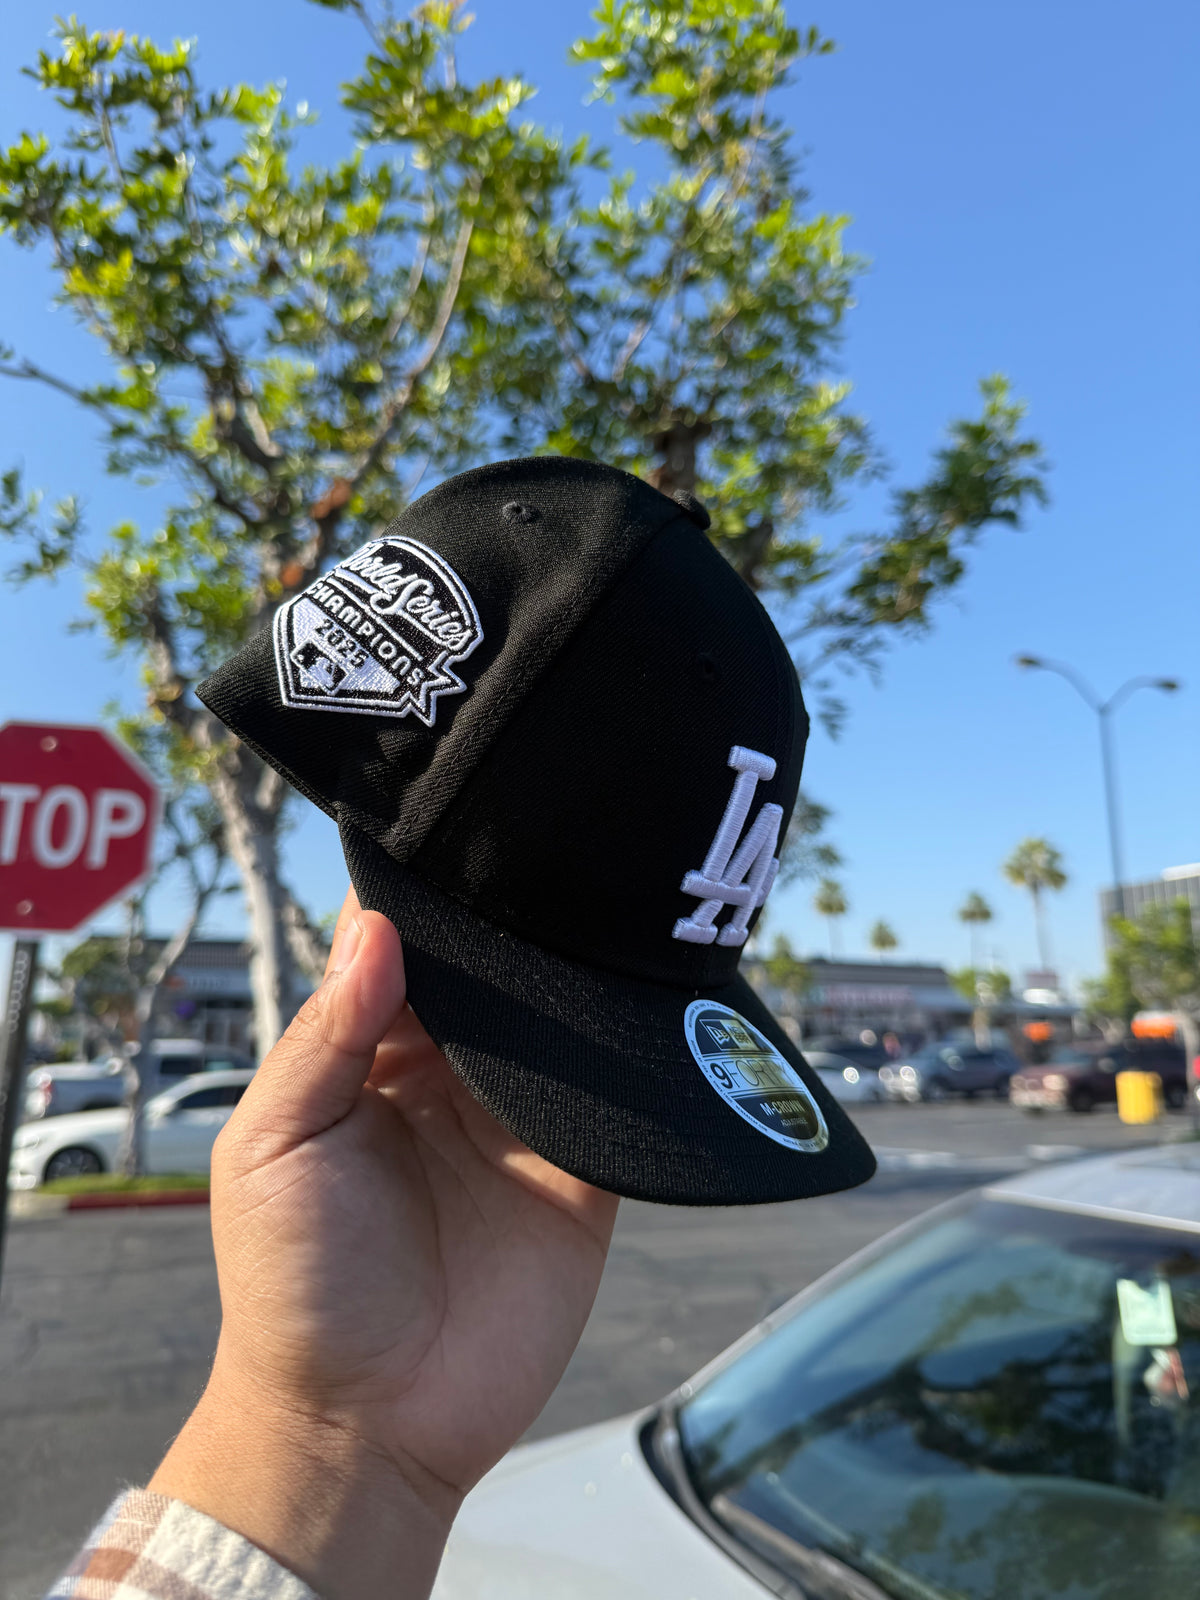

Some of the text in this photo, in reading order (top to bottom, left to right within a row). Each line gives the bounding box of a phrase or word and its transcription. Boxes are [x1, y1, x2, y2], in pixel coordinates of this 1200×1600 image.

[306, 581, 425, 686] CHAMPIONS
[315, 618, 370, 668] 2025
[370, 579, 473, 651] Series
[672, 745, 784, 947] LA
[760, 1100, 806, 1116] M-CROWN
